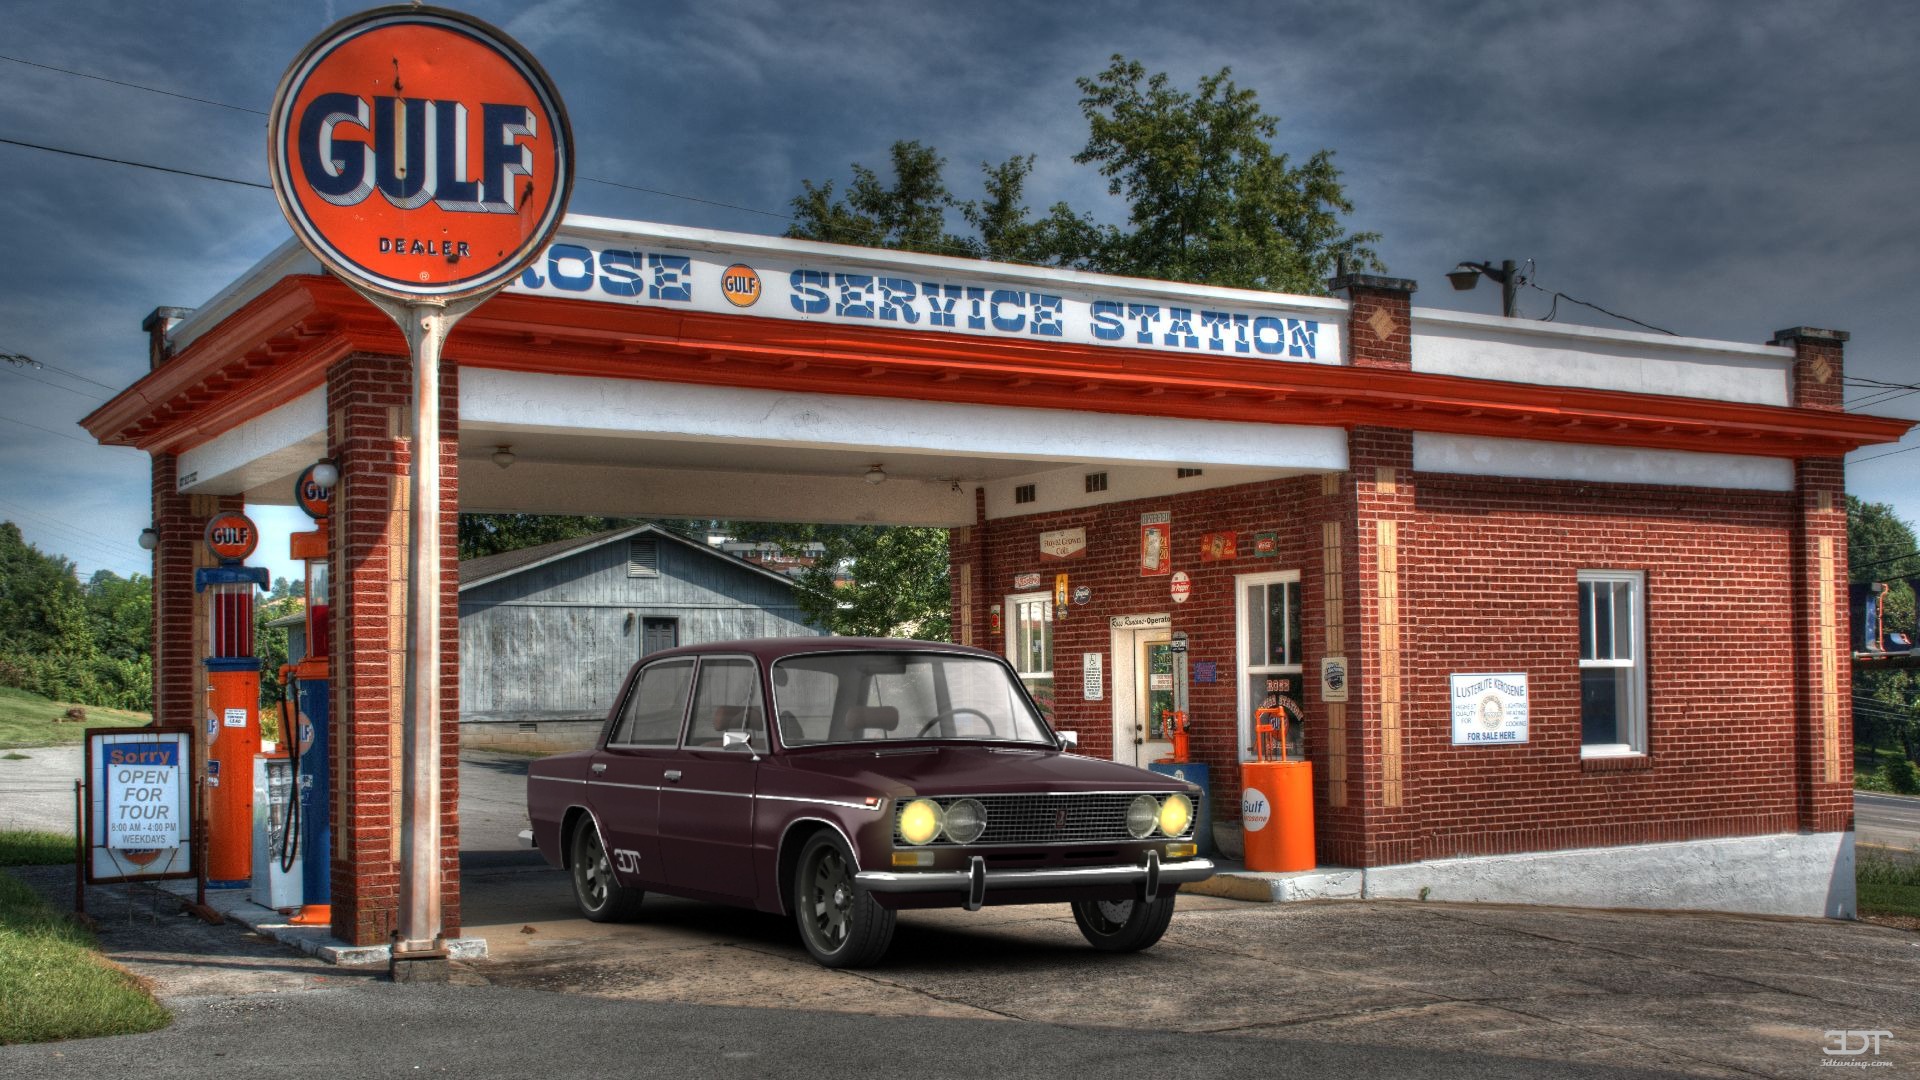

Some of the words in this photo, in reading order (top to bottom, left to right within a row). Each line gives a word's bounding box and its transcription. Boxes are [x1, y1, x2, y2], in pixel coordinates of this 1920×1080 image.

[300, 92, 537, 214] GULF
[379, 238, 471, 258] DEALER
[724, 275, 757, 294] GULF
[789, 269, 1063, 337] SERVICE
[1090, 300, 1318, 359] STATION
[305, 481, 328, 501] GU
[213, 528, 248, 546] GULF
[1456, 678, 1492, 697] LUSTERLITE
[1494, 678, 1524, 696] KEROSENE
[1467, 733, 1480, 741] FOR
[1482, 732, 1498, 740] SALE
[1499, 731, 1516, 740] HERE
[111, 750, 170, 765] Sorry
[118, 770, 169, 784] OPEN
[124, 788, 162, 802] FOR
[118, 806, 169, 820] TOUR
[1243, 800, 1264, 813] Gulf
[129, 823, 141, 832] AM
[147, 823, 163, 832] 4:00
[165, 823, 176, 831] PM
[122, 834, 166, 844] WEEKDAYS
